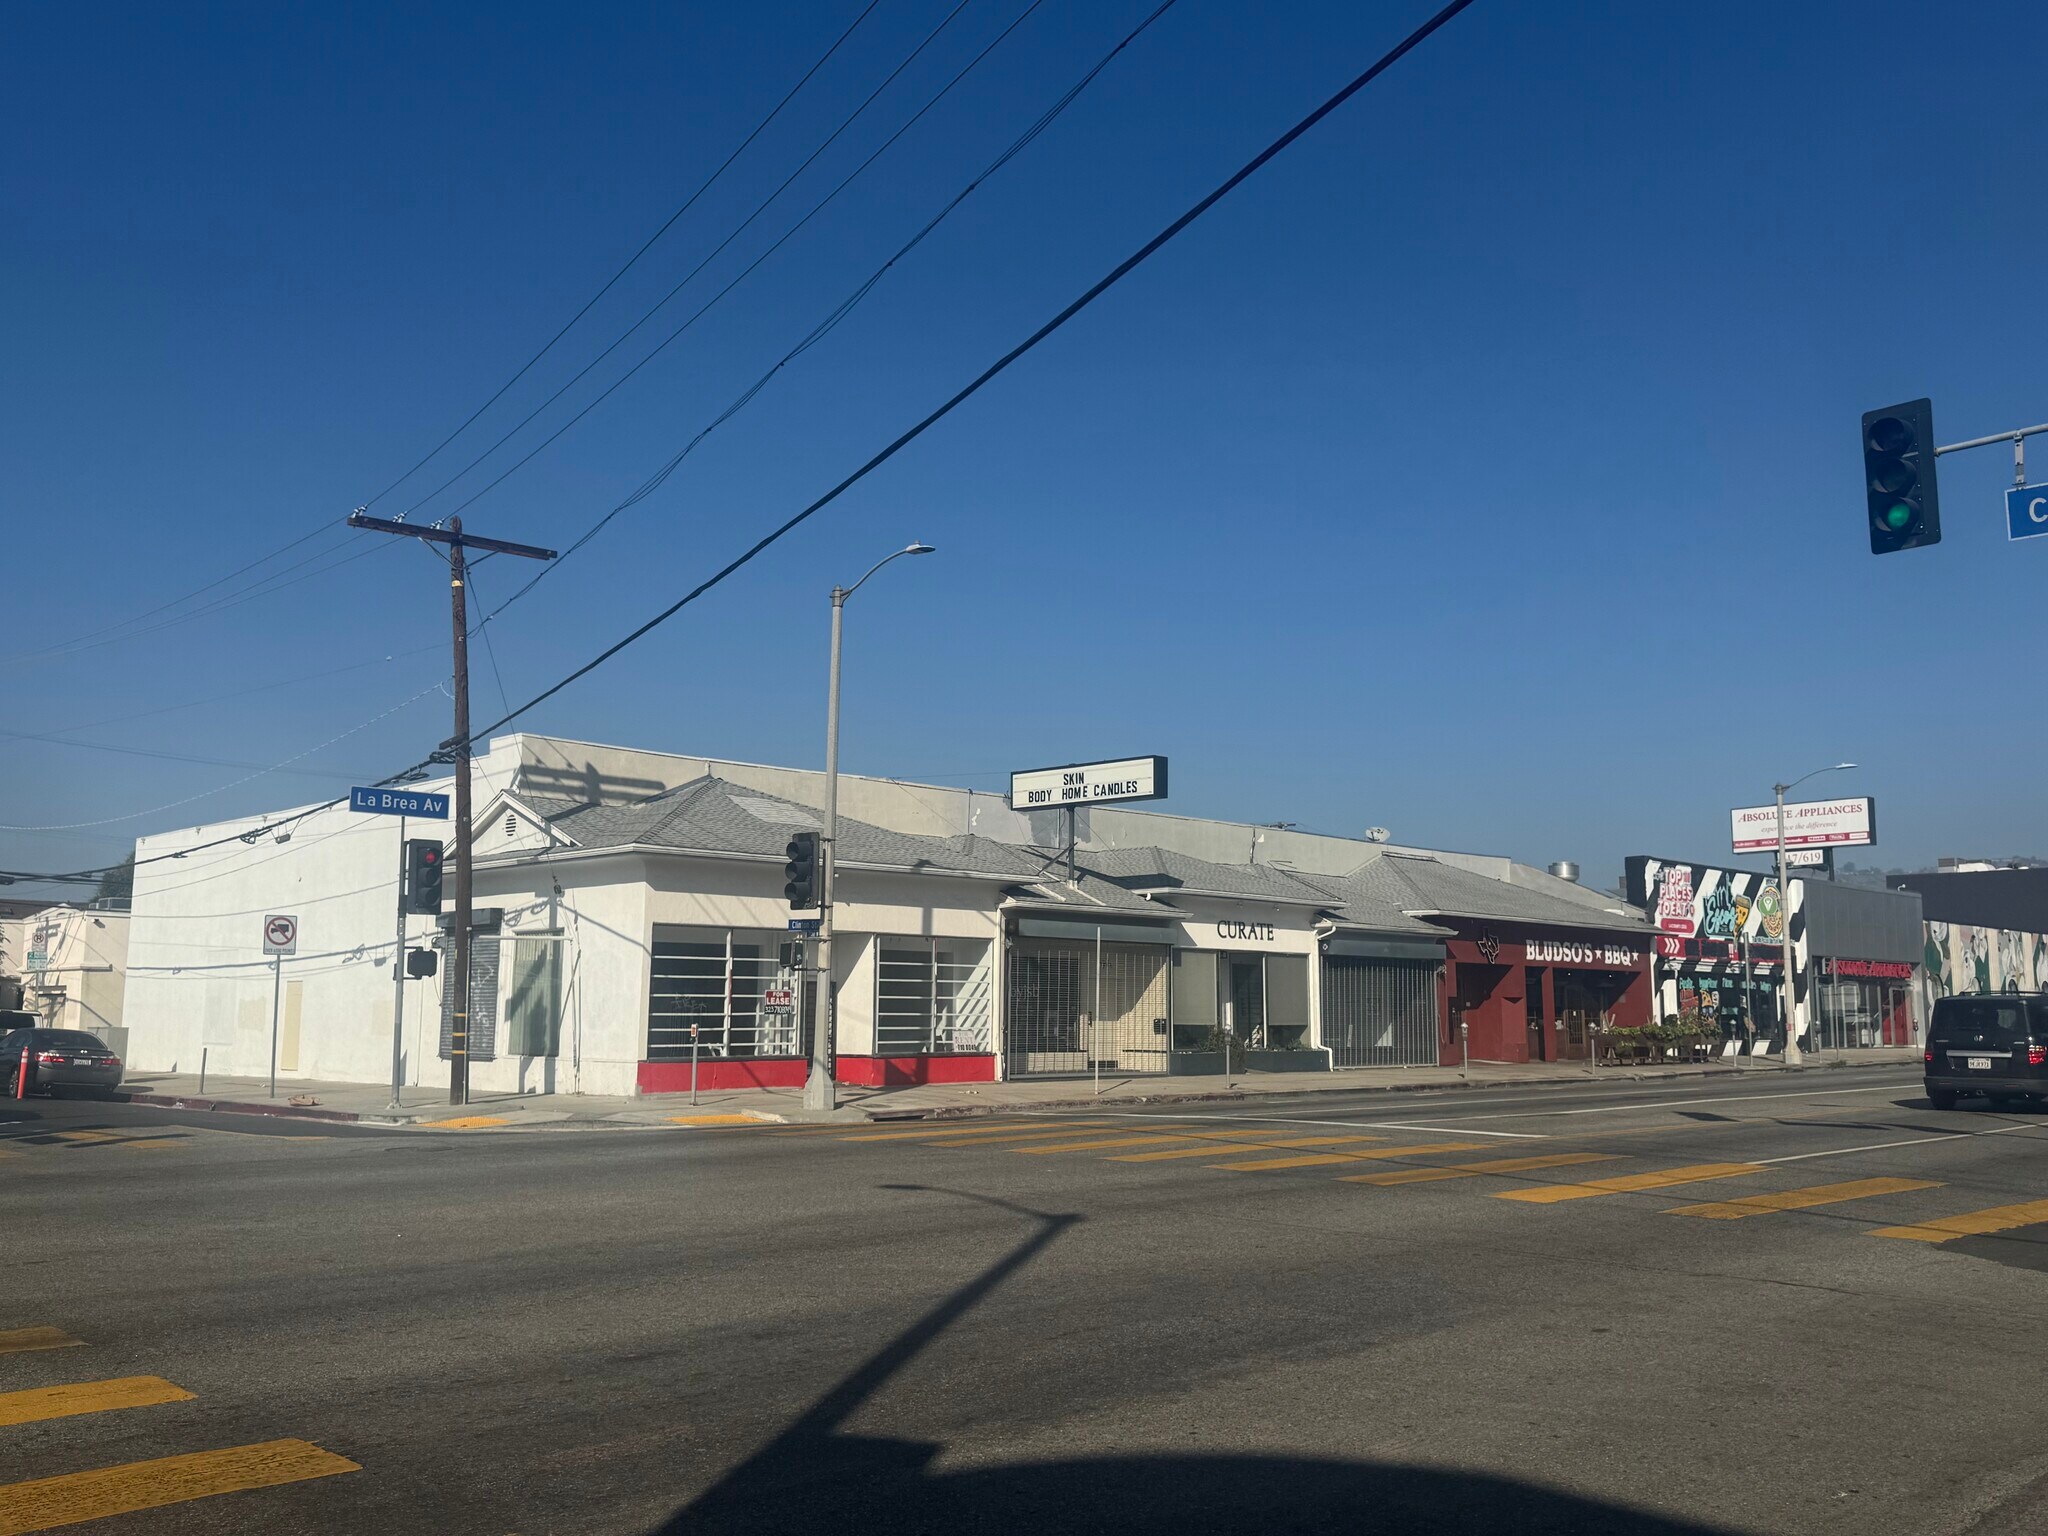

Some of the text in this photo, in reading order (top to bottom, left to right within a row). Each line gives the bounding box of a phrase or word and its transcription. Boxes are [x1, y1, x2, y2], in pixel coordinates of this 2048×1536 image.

[1063, 772, 1085, 786] SKIN
[1028, 780, 1138, 803] BODY HOME CANDLES
[357, 792, 442, 812] La Brea Av
[1738, 804, 1863, 823] ABSOLUE APPLIANCES
[1761, 820, 1838, 833] expernce the difference
[1664, 867, 1682, 886] TOP
[1660, 884, 1693, 902] PLACES
[1658, 899, 1671, 917] TO
[1217, 920, 1274, 941] CURATE
[1526, 939, 1632, 966] BLUDSO'S BBQ
[766, 997, 790, 1005] LEASE
